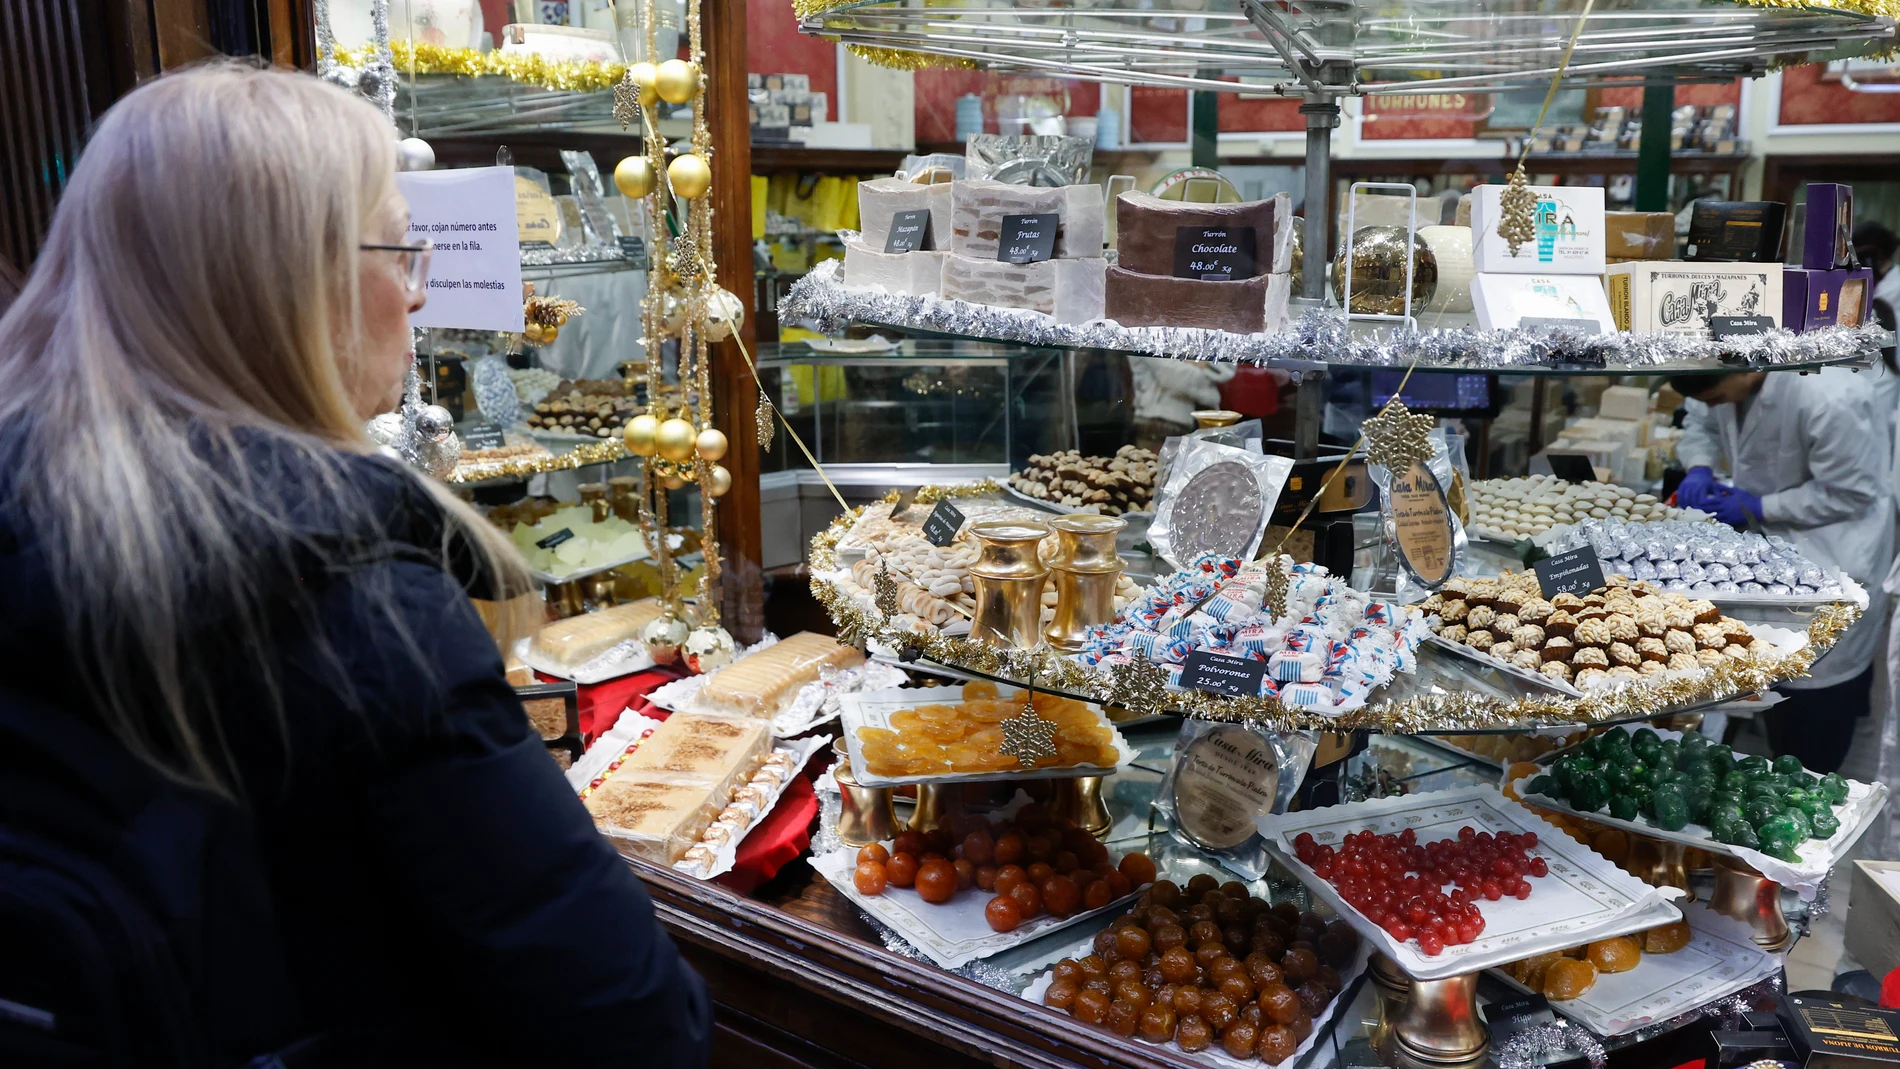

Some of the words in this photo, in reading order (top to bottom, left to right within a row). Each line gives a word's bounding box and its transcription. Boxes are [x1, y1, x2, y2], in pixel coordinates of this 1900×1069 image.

[1537, 211, 1574, 225] IRA
[411, 222, 431, 233] favor,
[431, 222, 449, 233] cojan
[450, 221, 477, 232] número
[477, 222, 497, 231] antes
[1016, 231, 1040, 240] Frutas
[1202, 230, 1227, 238] Turrón
[461, 240, 469, 251] la
[469, 240, 483, 251] fila.
[1009, 245, 1030, 255] 48.00€
[1191, 243, 1238, 254] Chocolate
[1189, 259, 1219, 271] 48.00€
[1221, 265, 1233, 274] Kg
[424, 280, 429, 290] y
[430, 278, 461, 290] disculpen
[462, 279, 472, 289] las
[473, 280, 505, 290] molestias
[1659, 291, 1692, 327] Casa
[1391, 477, 1412, 493] Casa
[1564, 554, 1578, 562] Mira
[1549, 563, 1589, 580] Empiñonadas
[1556, 580, 1578, 594] 58.00€
[1240, 628, 1265, 636] MIRA
[1225, 658, 1244, 666] Mira
[1198, 664, 1251, 679] Polvorones
[1196, 676, 1227, 688] 25.00€
[1227, 684, 1239, 693] Kg
[1207, 731, 1237, 754] Casa
[1237, 748, 1274, 771] Mira
[1215, 751, 1237, 766] DESDE
[1515, 1000, 1530, 1008] Mira
[1511, 1013, 1532, 1024] Higo
[1822, 1039, 1852, 1048] JIJONA
[1853, 1042, 1865, 1050] DE
